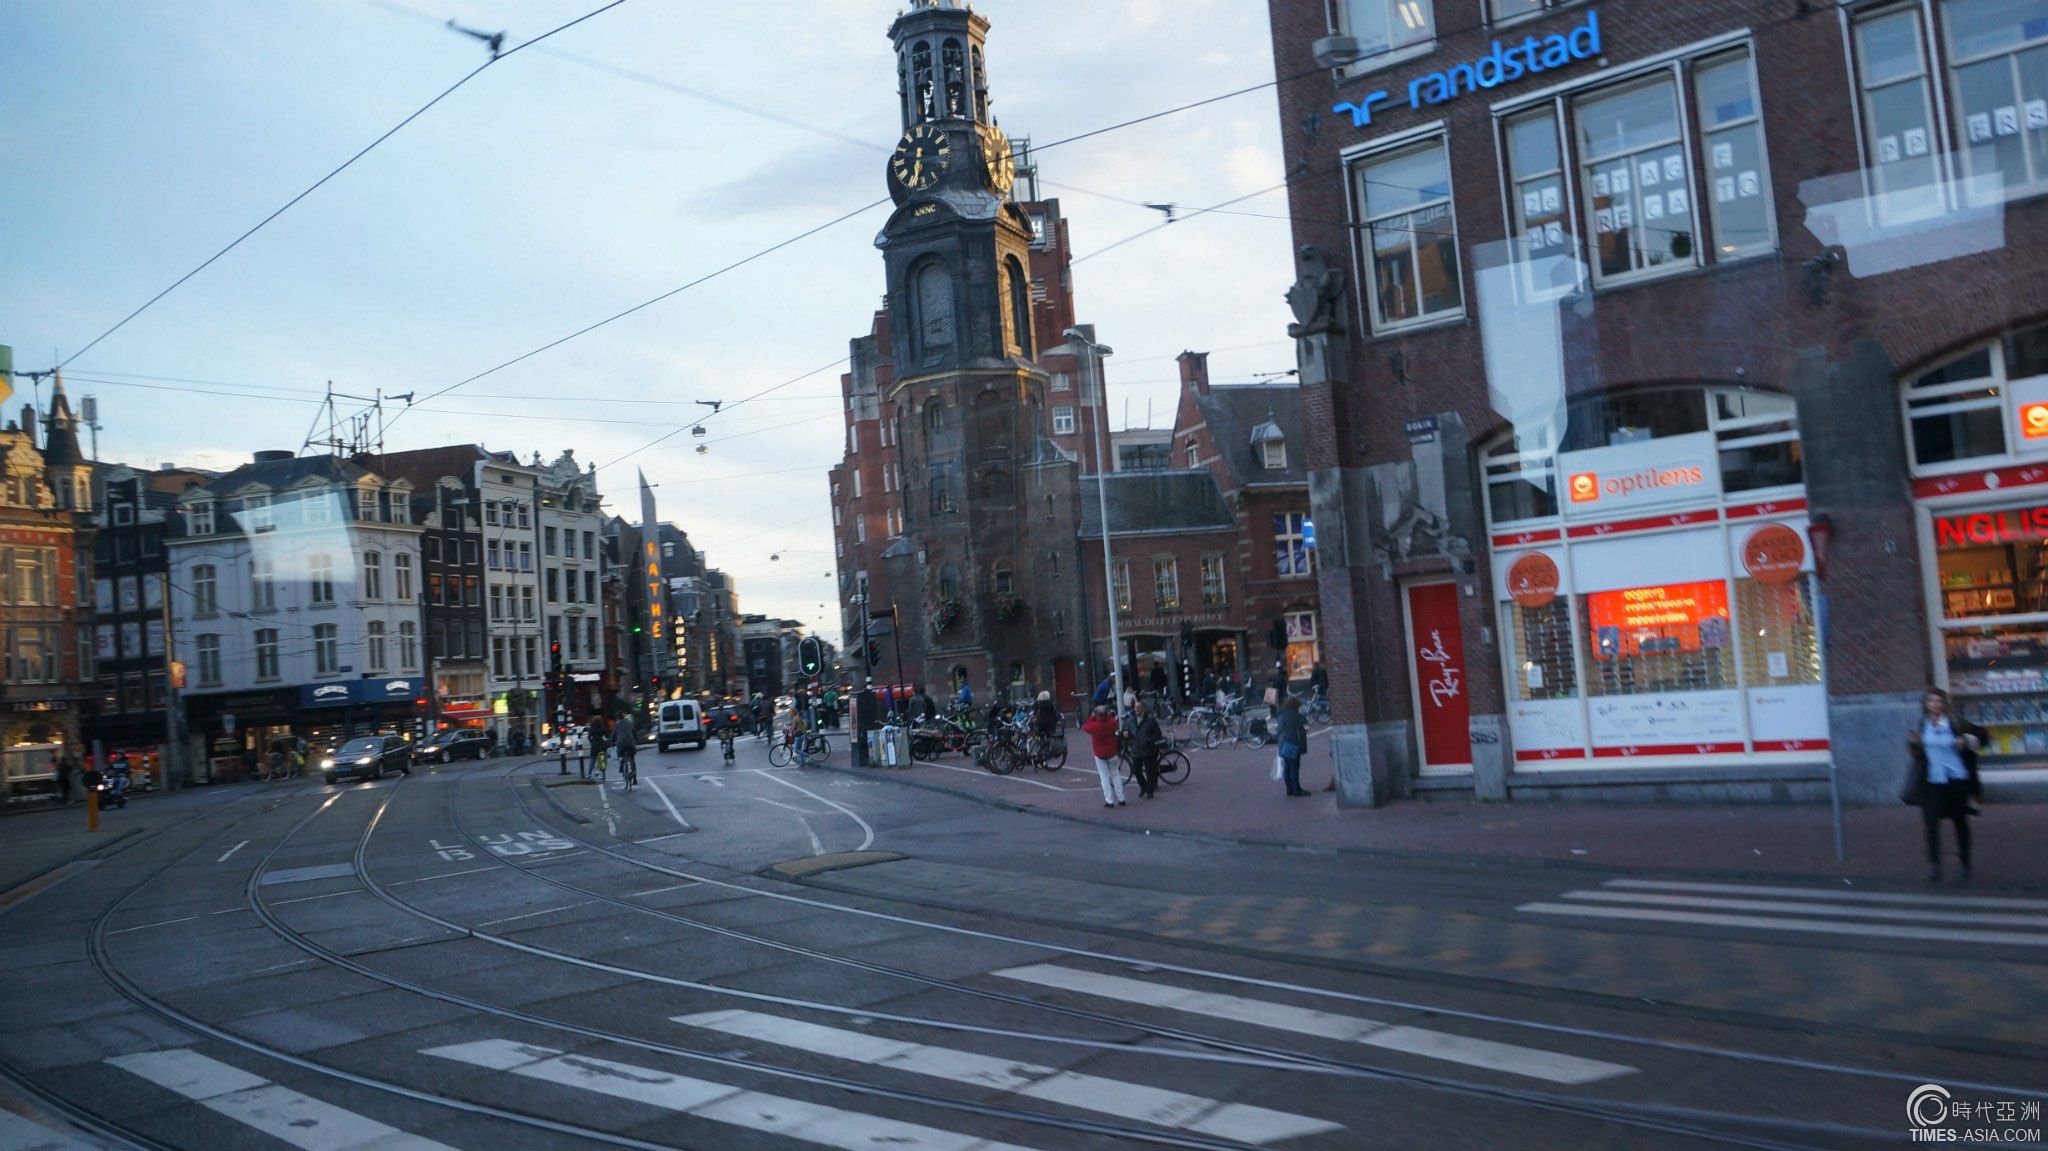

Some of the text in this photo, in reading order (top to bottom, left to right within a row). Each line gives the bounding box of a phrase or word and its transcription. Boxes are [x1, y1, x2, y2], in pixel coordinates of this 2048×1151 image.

[1408, 9, 1599, 108] randstad
[1604, 465, 1704, 497] optilens
[1419, 628, 1460, 708] Ray-Ban
